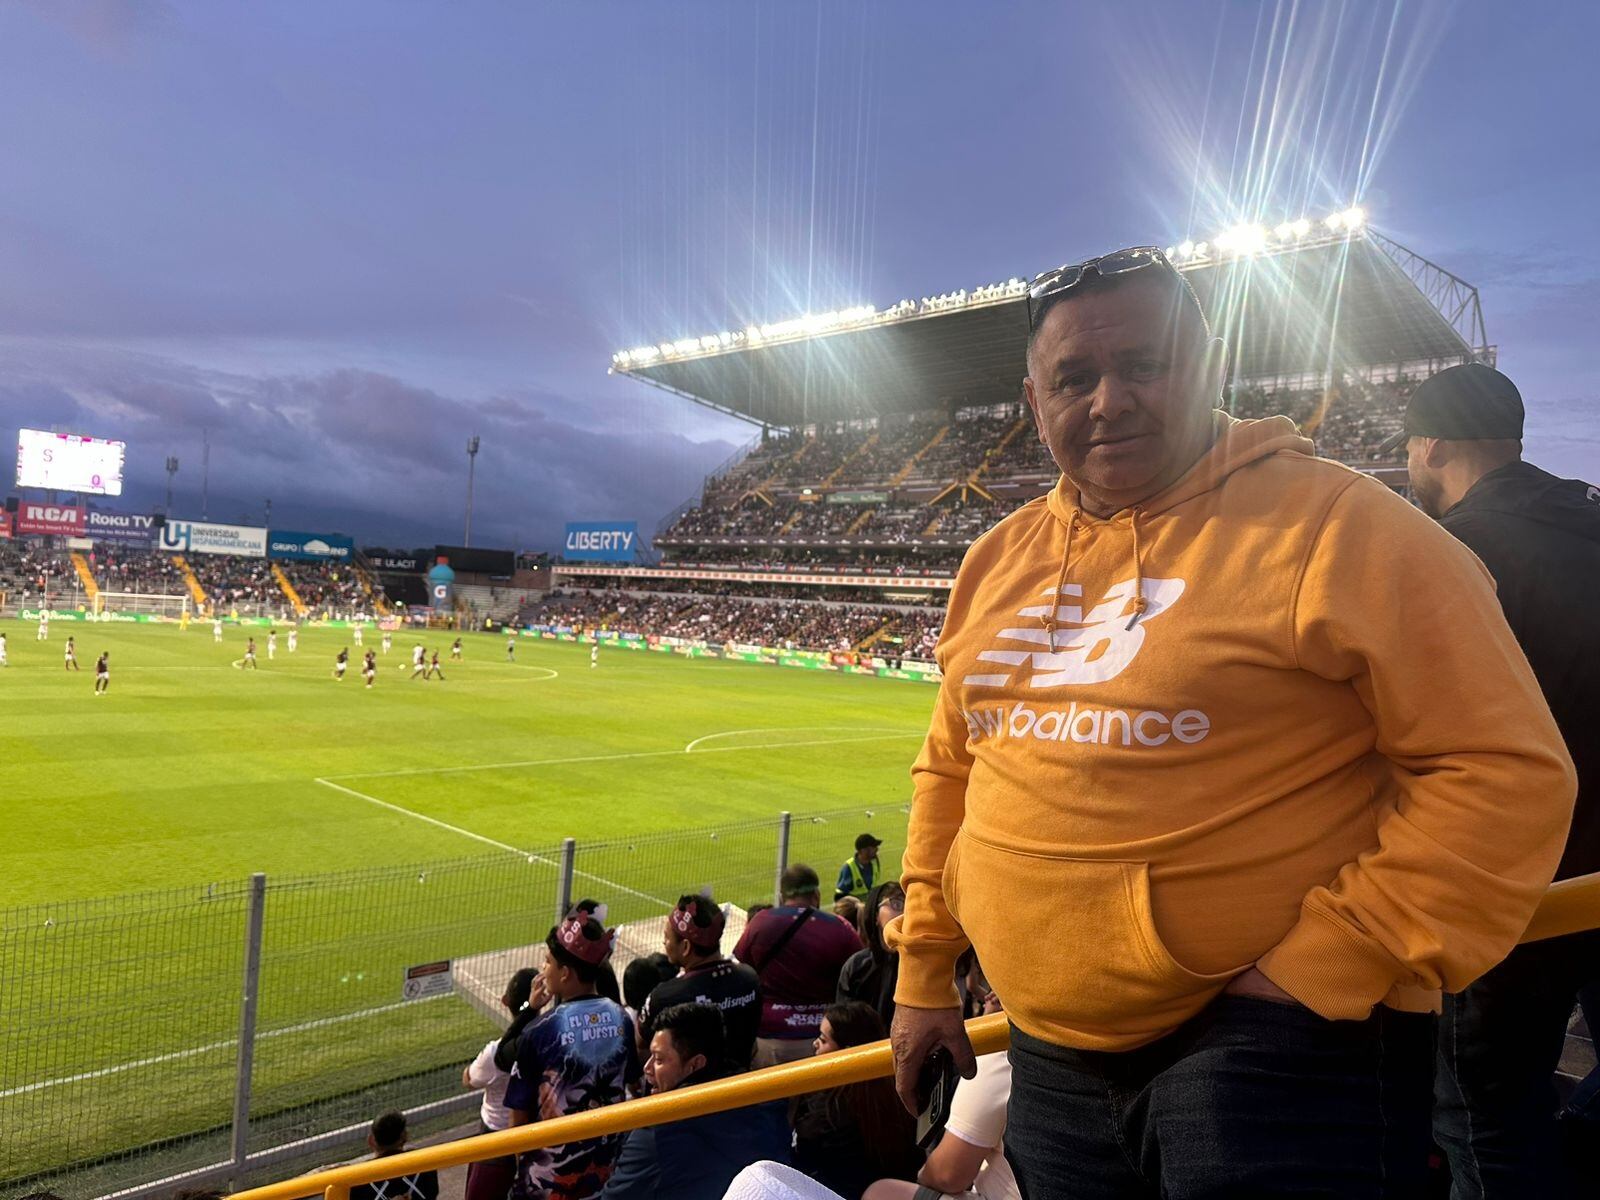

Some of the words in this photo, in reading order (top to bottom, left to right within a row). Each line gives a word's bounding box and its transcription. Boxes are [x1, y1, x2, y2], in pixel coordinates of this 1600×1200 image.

[27, 506, 77, 523] RCA
[132, 515, 153, 528] TV
[192, 527, 240, 539] UNIVERSIDAD
[191, 538, 263, 550] HISPANOAMERICANA
[566, 531, 633, 550] LIBERTY
[272, 542, 298, 553] GRUPO
[434, 585, 447, 598] G
[966, 707, 1003, 739] ew
[1008, 701, 1210, 747] balance
[569, 1014, 582, 1028] EL
[561, 1031, 575, 1046] ES
